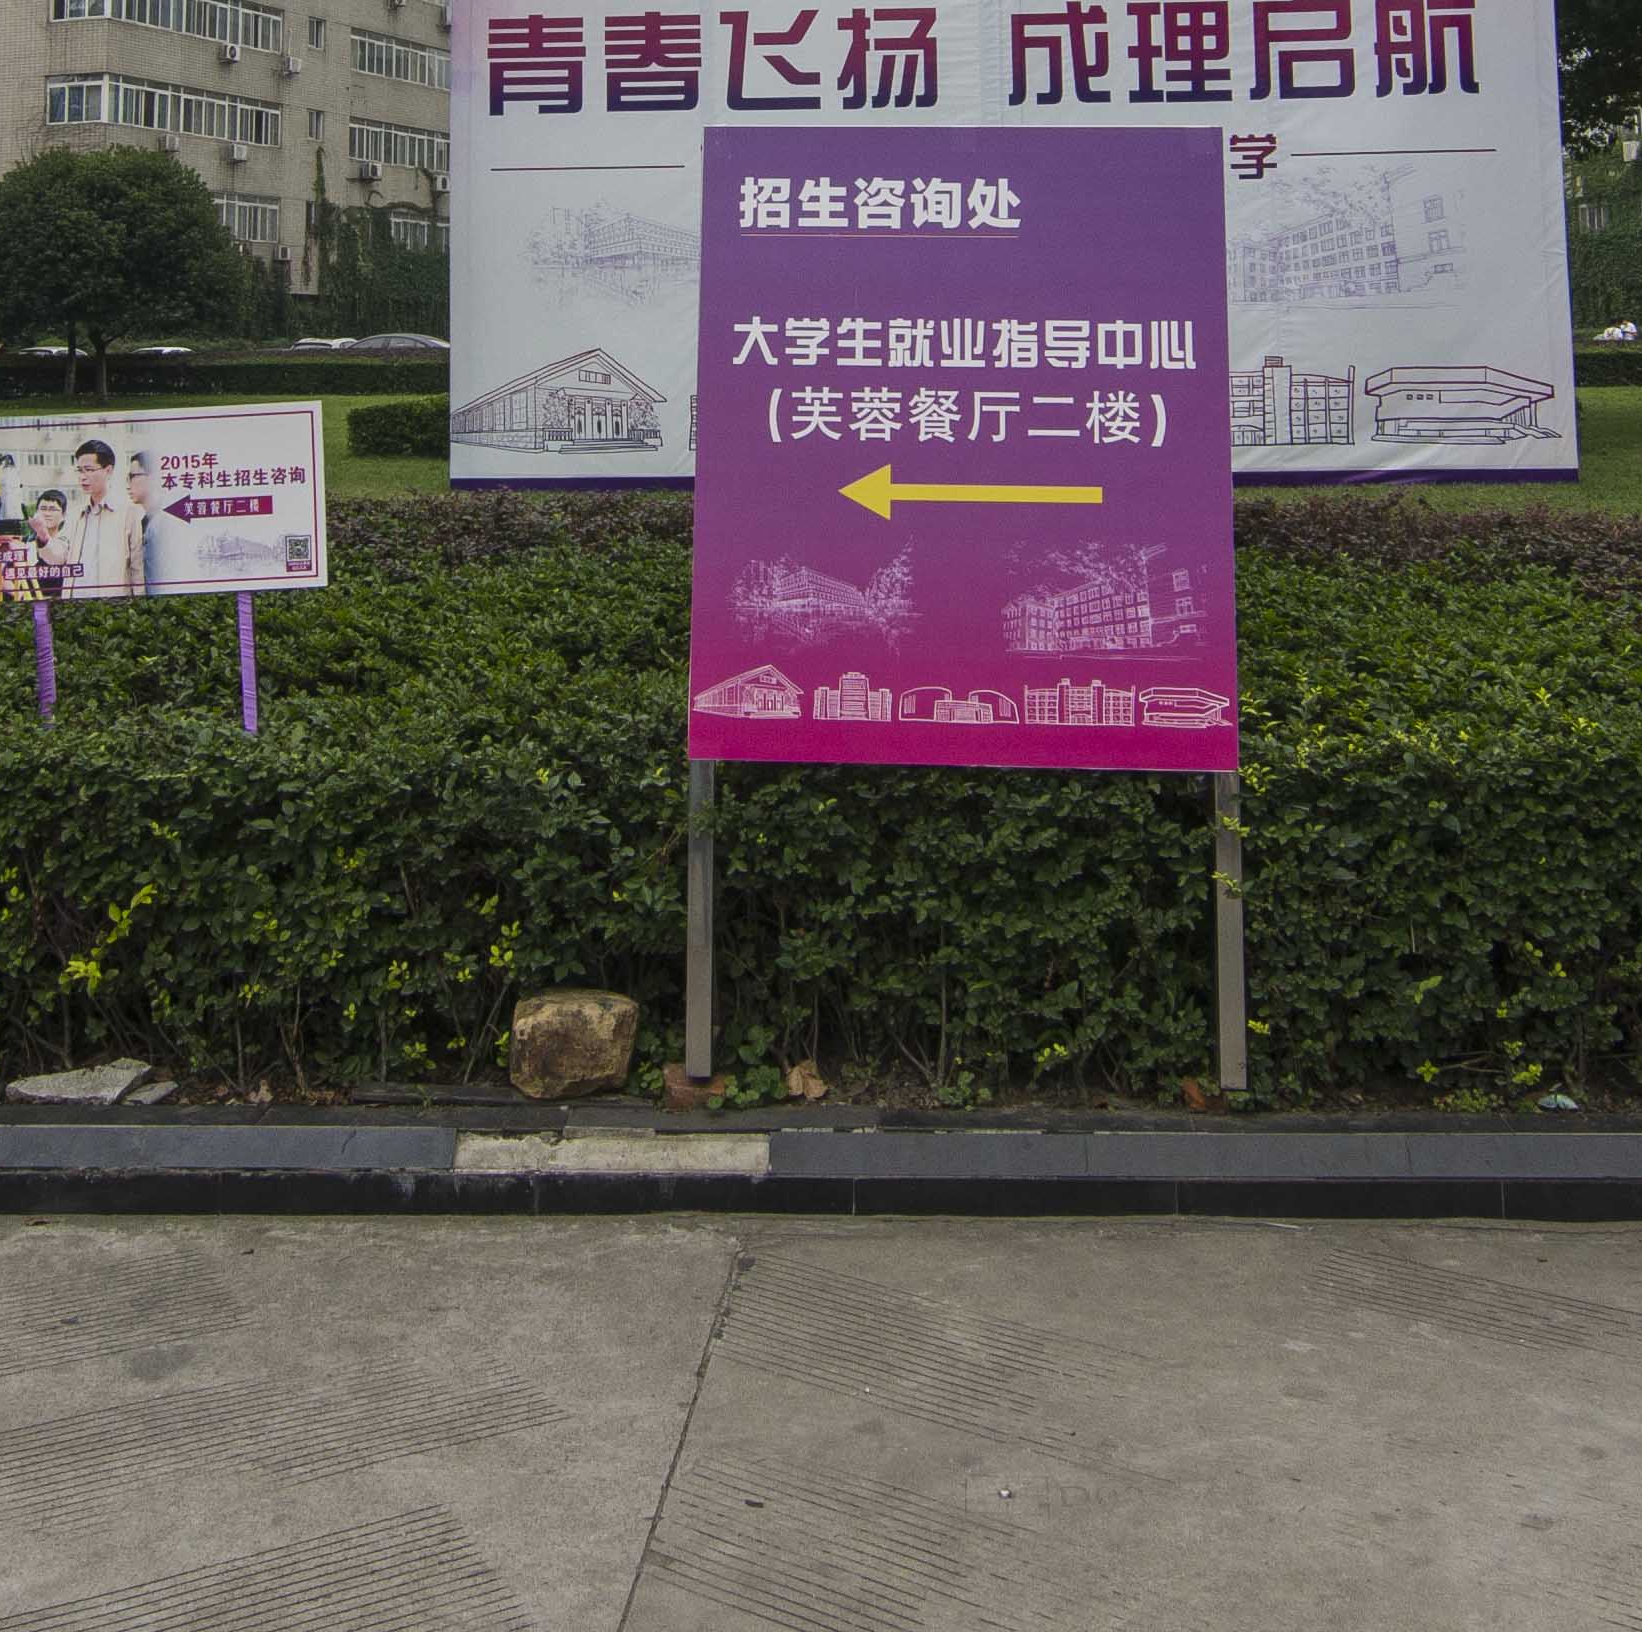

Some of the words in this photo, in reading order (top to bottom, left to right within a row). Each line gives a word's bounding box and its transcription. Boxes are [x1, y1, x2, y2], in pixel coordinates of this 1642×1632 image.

[487, 7, 938, 115] 青春飞扬
[739, 176, 1022, 230] 招生咨询处
[732, 316, 1197, 370] 大学生就业指导中心
[160, 451, 219, 471] 2015年
[161, 465, 307, 491] 本专科生招生咨询
